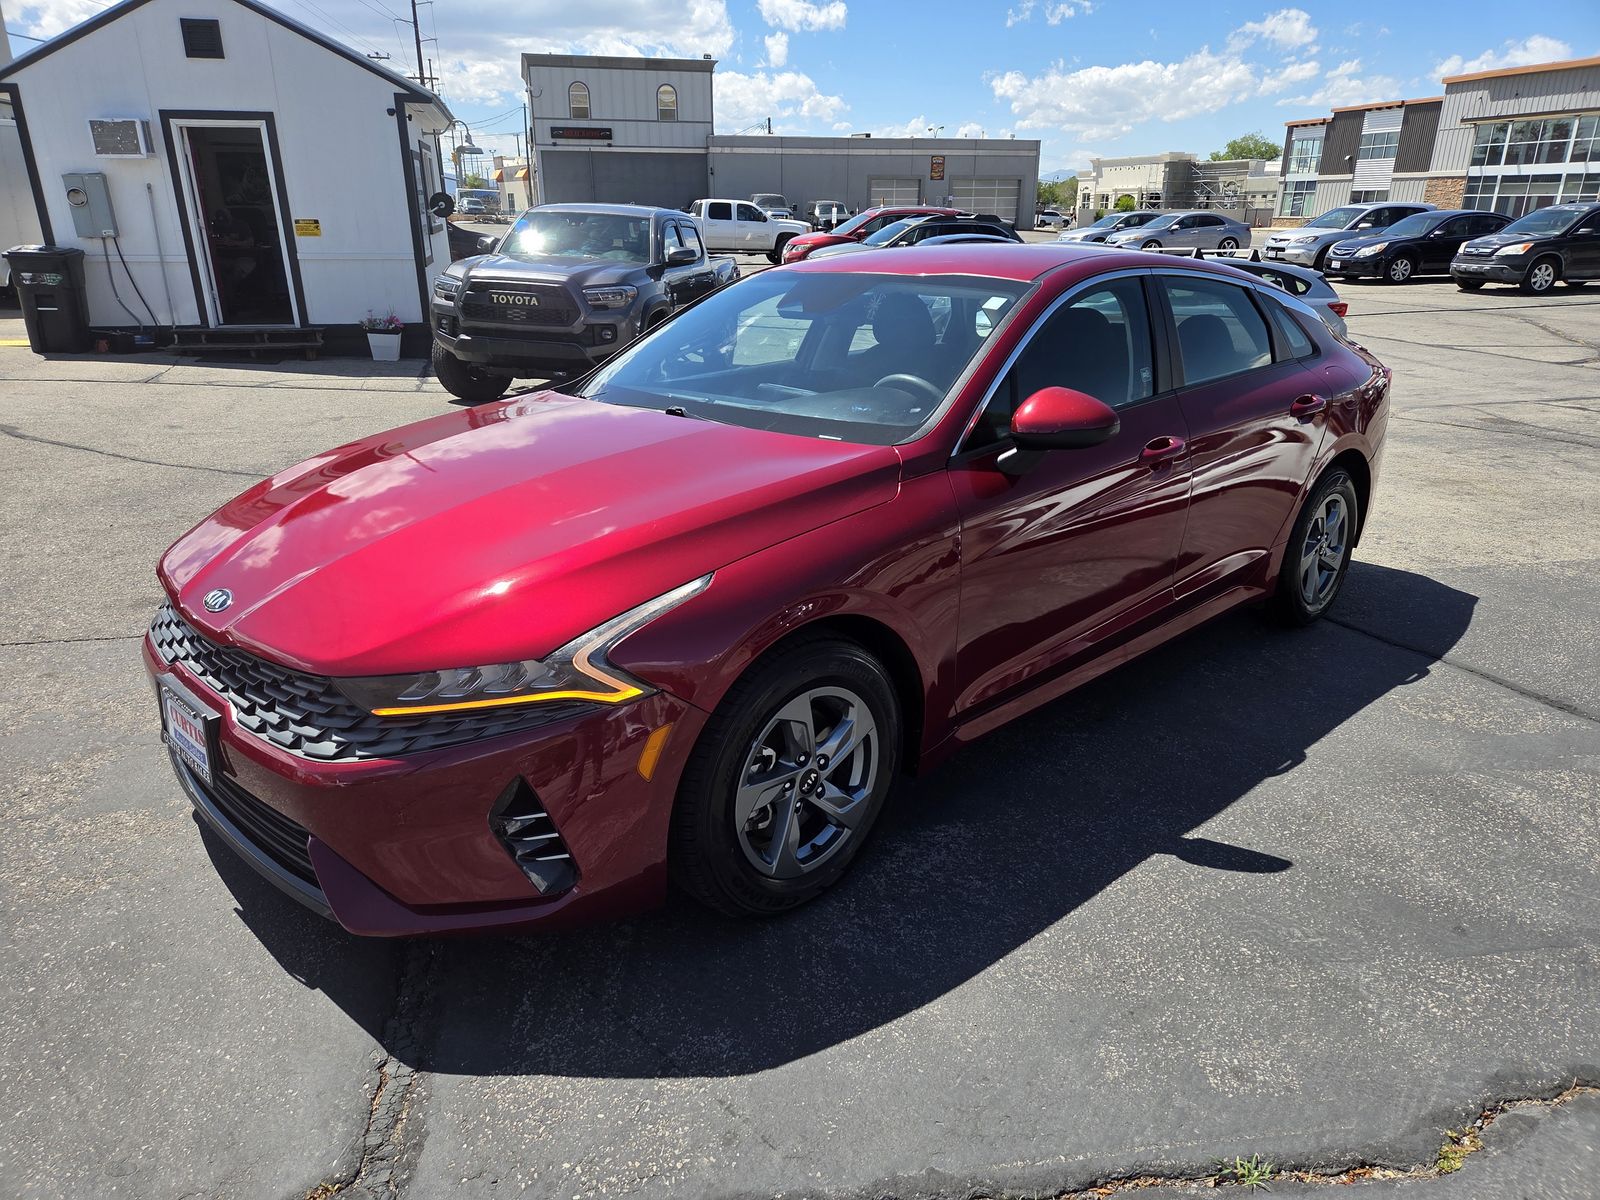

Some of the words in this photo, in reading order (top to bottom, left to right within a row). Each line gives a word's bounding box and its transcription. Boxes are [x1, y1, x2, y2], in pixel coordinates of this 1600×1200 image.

[491, 294, 539, 306] TOYOTA
[171, 704, 206, 747] CURTIS
[802, 772, 817, 792] KIA
